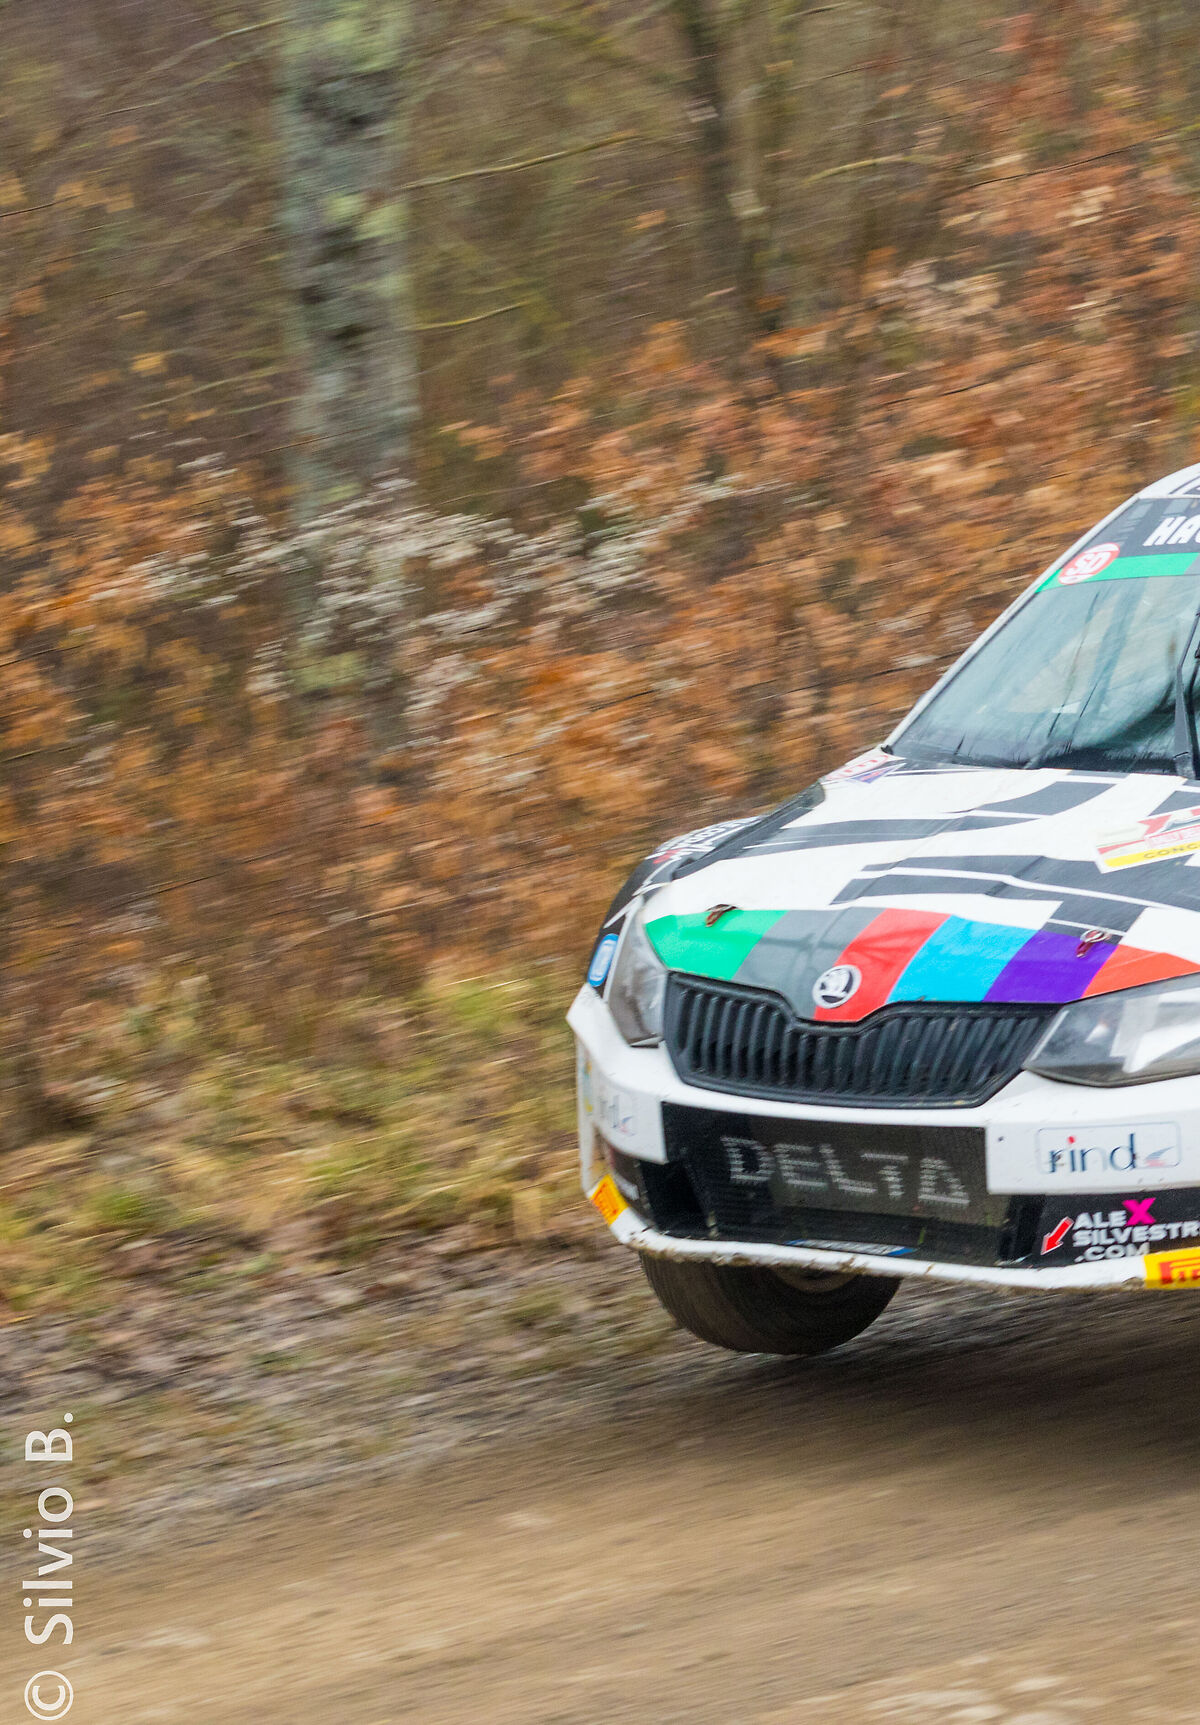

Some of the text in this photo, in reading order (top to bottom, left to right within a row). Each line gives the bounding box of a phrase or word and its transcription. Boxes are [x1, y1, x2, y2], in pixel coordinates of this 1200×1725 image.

[720, 1136, 970, 1206] DELTA
[1049, 1133, 1138, 1173] rind
[1072, 1197, 1156, 1230] ALEX
